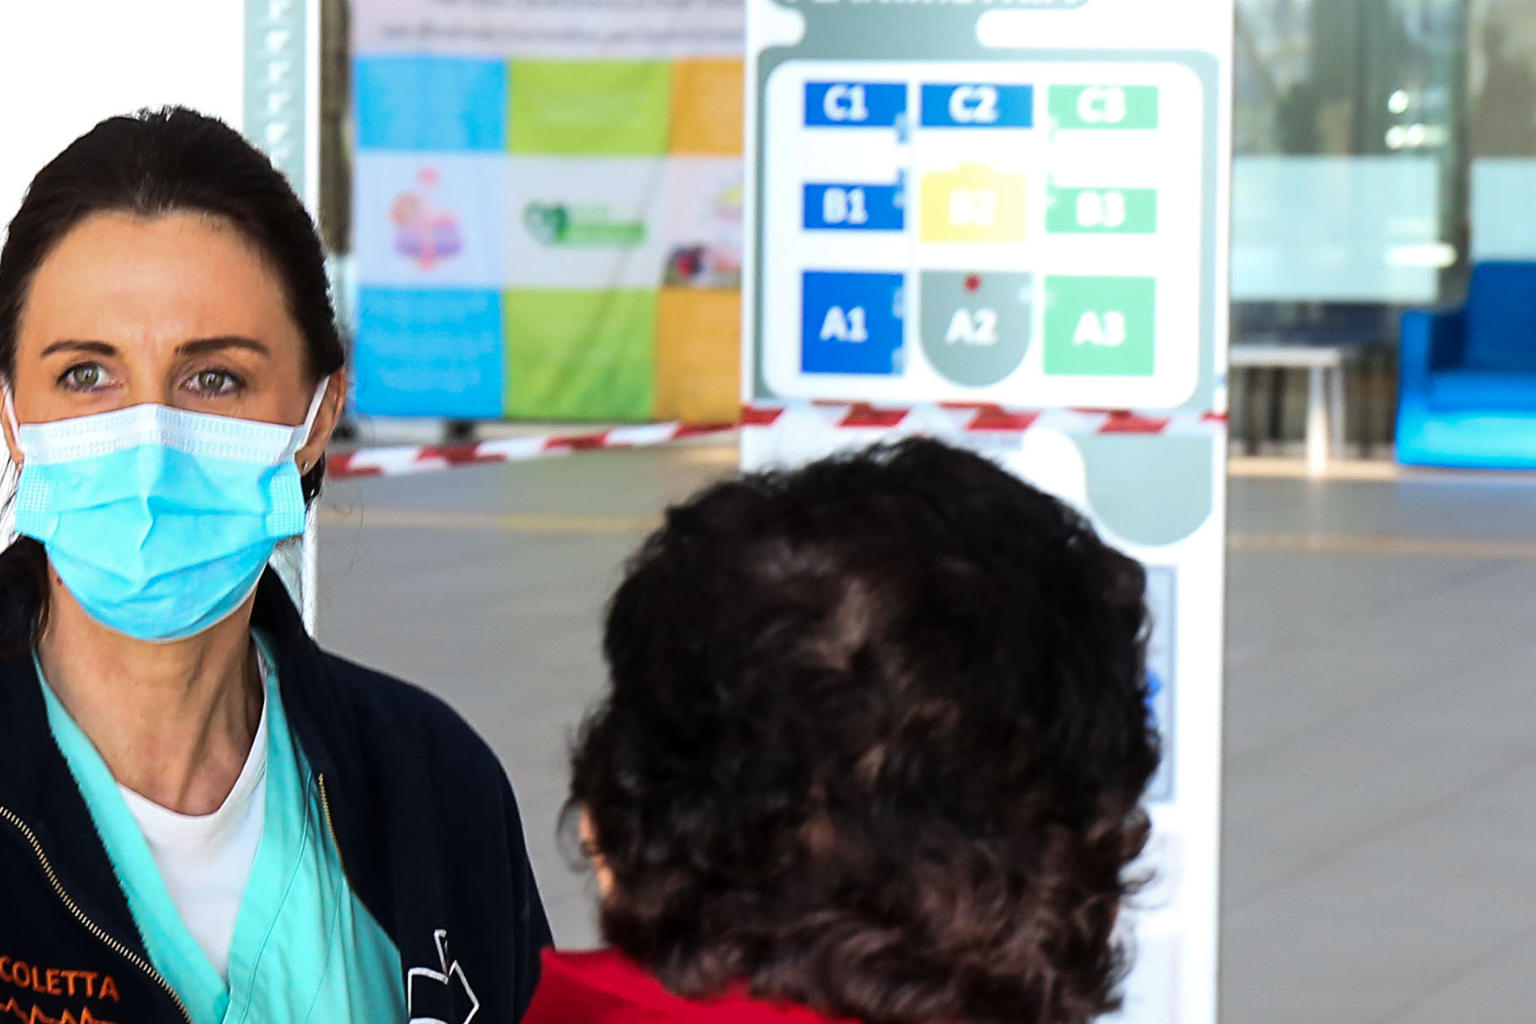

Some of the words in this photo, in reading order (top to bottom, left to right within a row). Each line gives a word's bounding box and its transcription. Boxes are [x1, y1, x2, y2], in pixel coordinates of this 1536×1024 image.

[823, 85, 868, 120] C1
[949, 85, 998, 122] C2
[1076, 86, 1126, 122] C3
[822, 189, 868, 224] B1
[949, 189, 996, 226] B2
[1076, 191, 1126, 227] B3
[820, 306, 868, 342] A1
[945, 308, 998, 346] A2
[1073, 310, 1126, 347] A3
